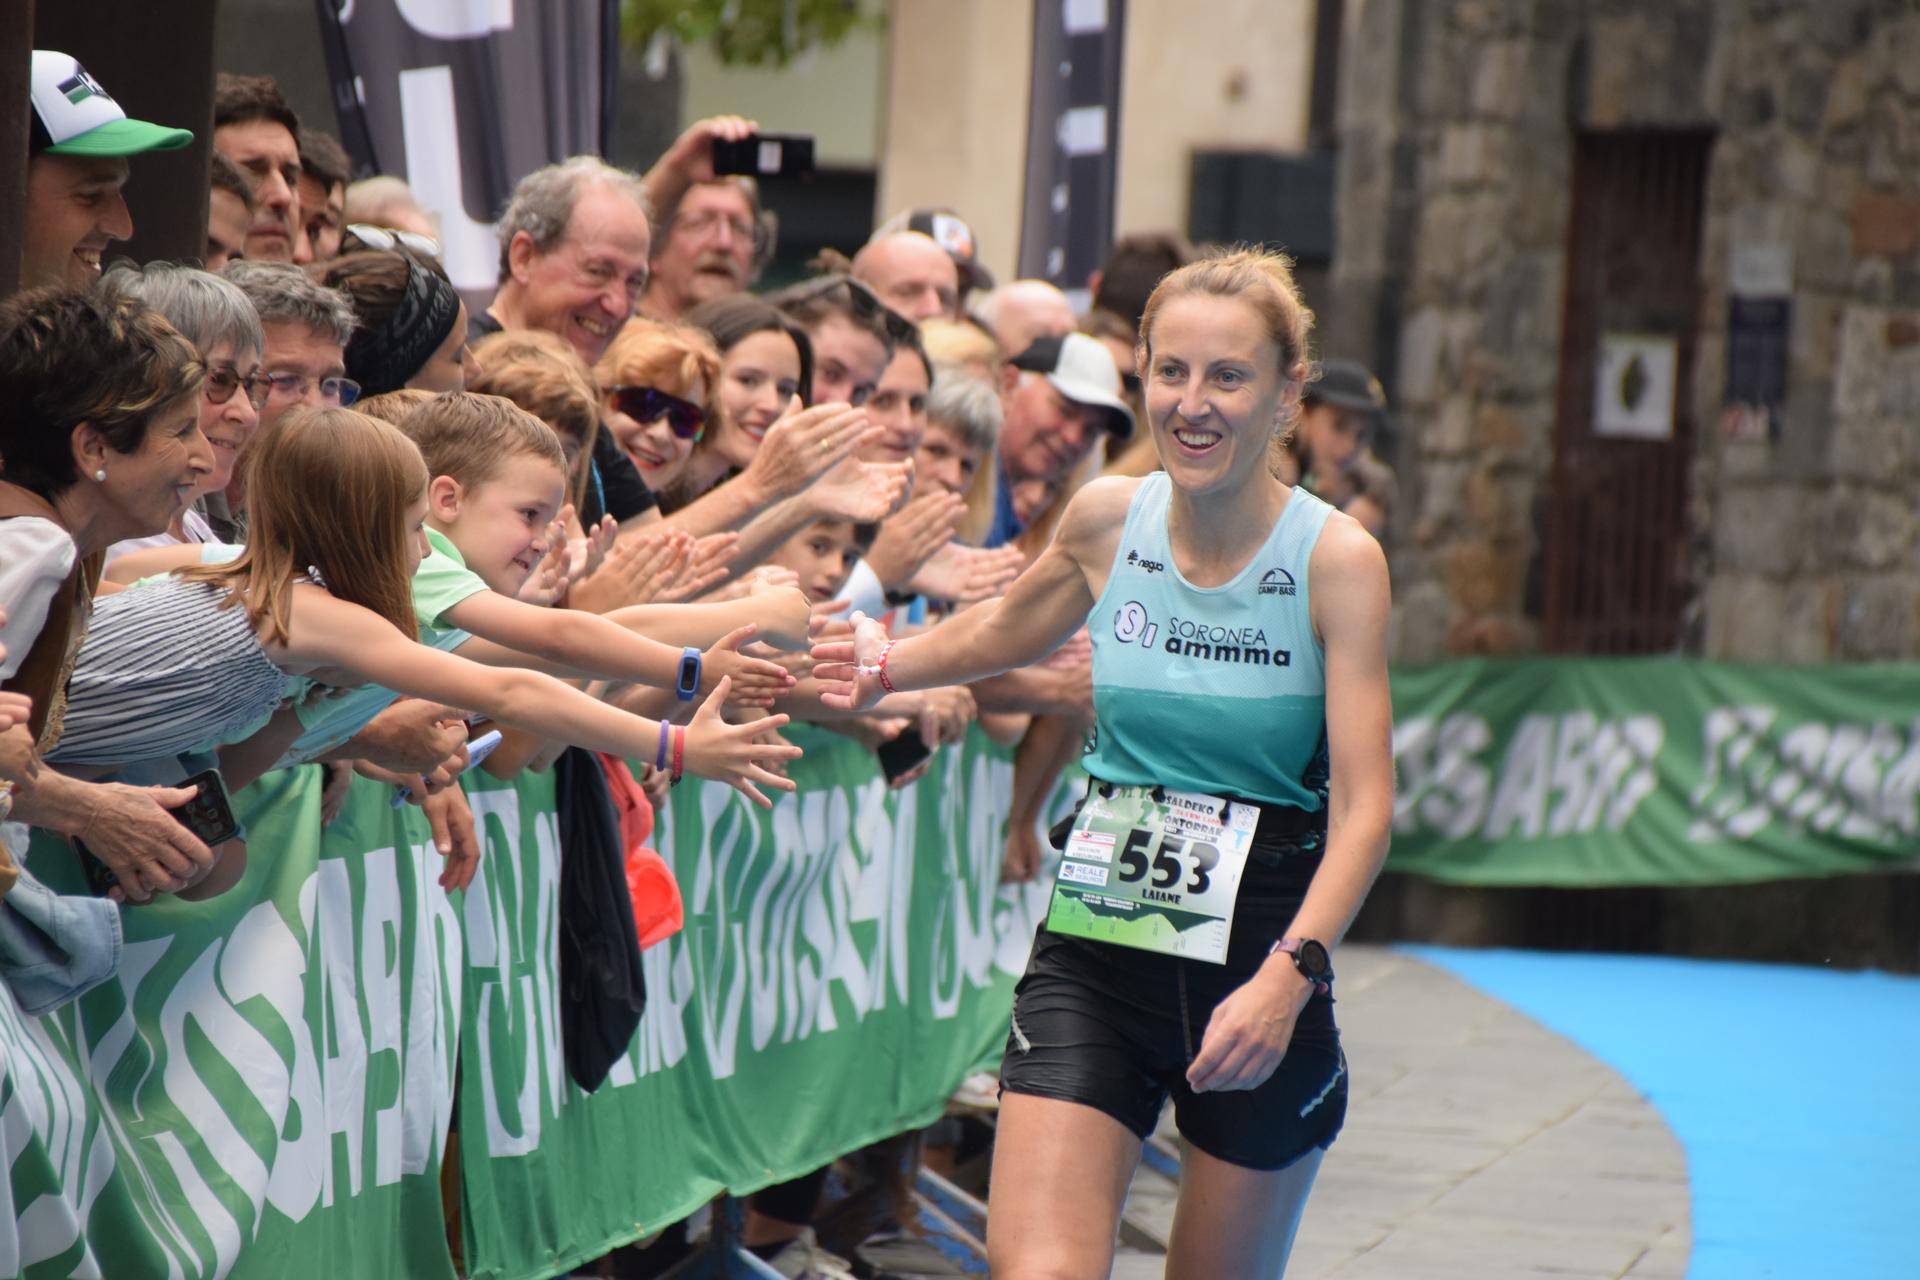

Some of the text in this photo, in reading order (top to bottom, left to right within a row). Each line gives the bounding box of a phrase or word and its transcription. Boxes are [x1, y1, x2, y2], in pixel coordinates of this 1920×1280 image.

[1258, 586, 1296, 597] CAMP BASE
[1168, 616, 1268, 647] SORONEA
[1165, 636, 1291, 667] ammma
[1076, 864, 1105, 878] REALE
[1119, 829, 1220, 895] 553
[1142, 888, 1182, 905] LAIANE
